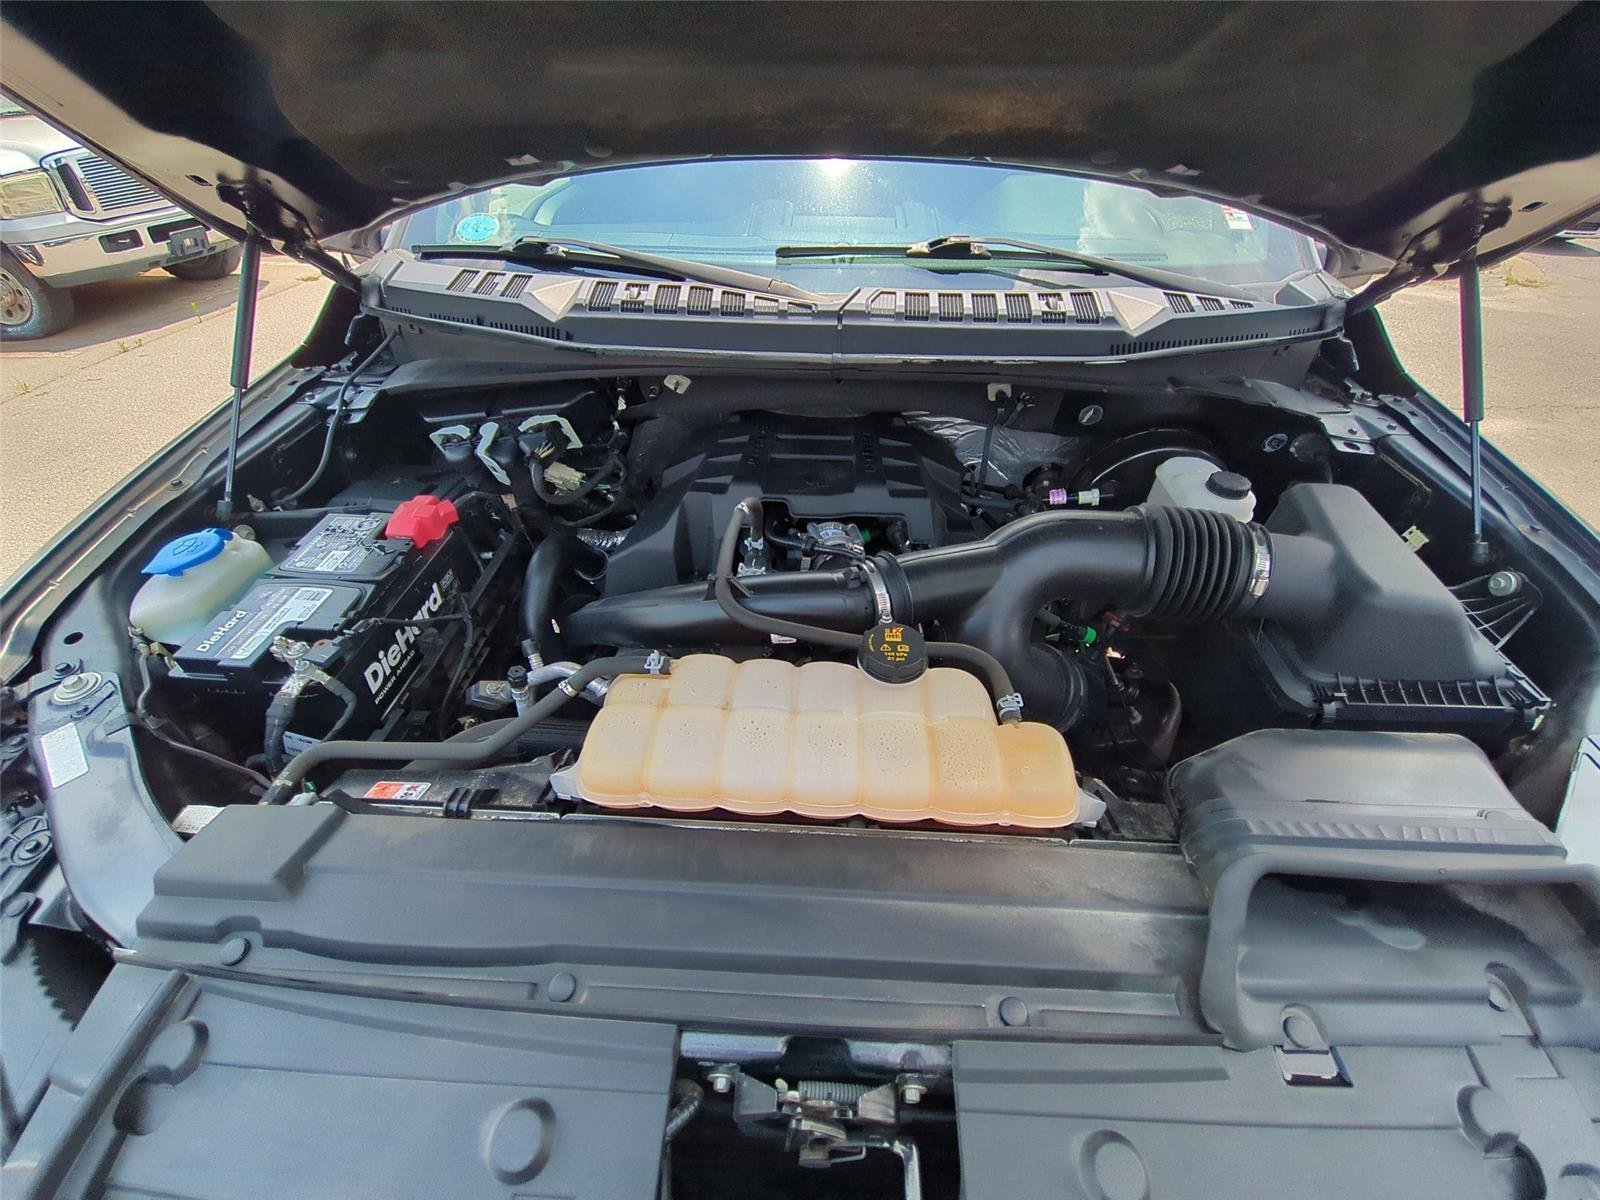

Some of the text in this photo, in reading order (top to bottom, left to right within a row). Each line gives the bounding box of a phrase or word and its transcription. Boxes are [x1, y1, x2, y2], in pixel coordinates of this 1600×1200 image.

[197, 610, 247, 652] DieHard
[364, 582, 443, 695] DieHard
[375, 650, 415, 705] POWER AHEAD
